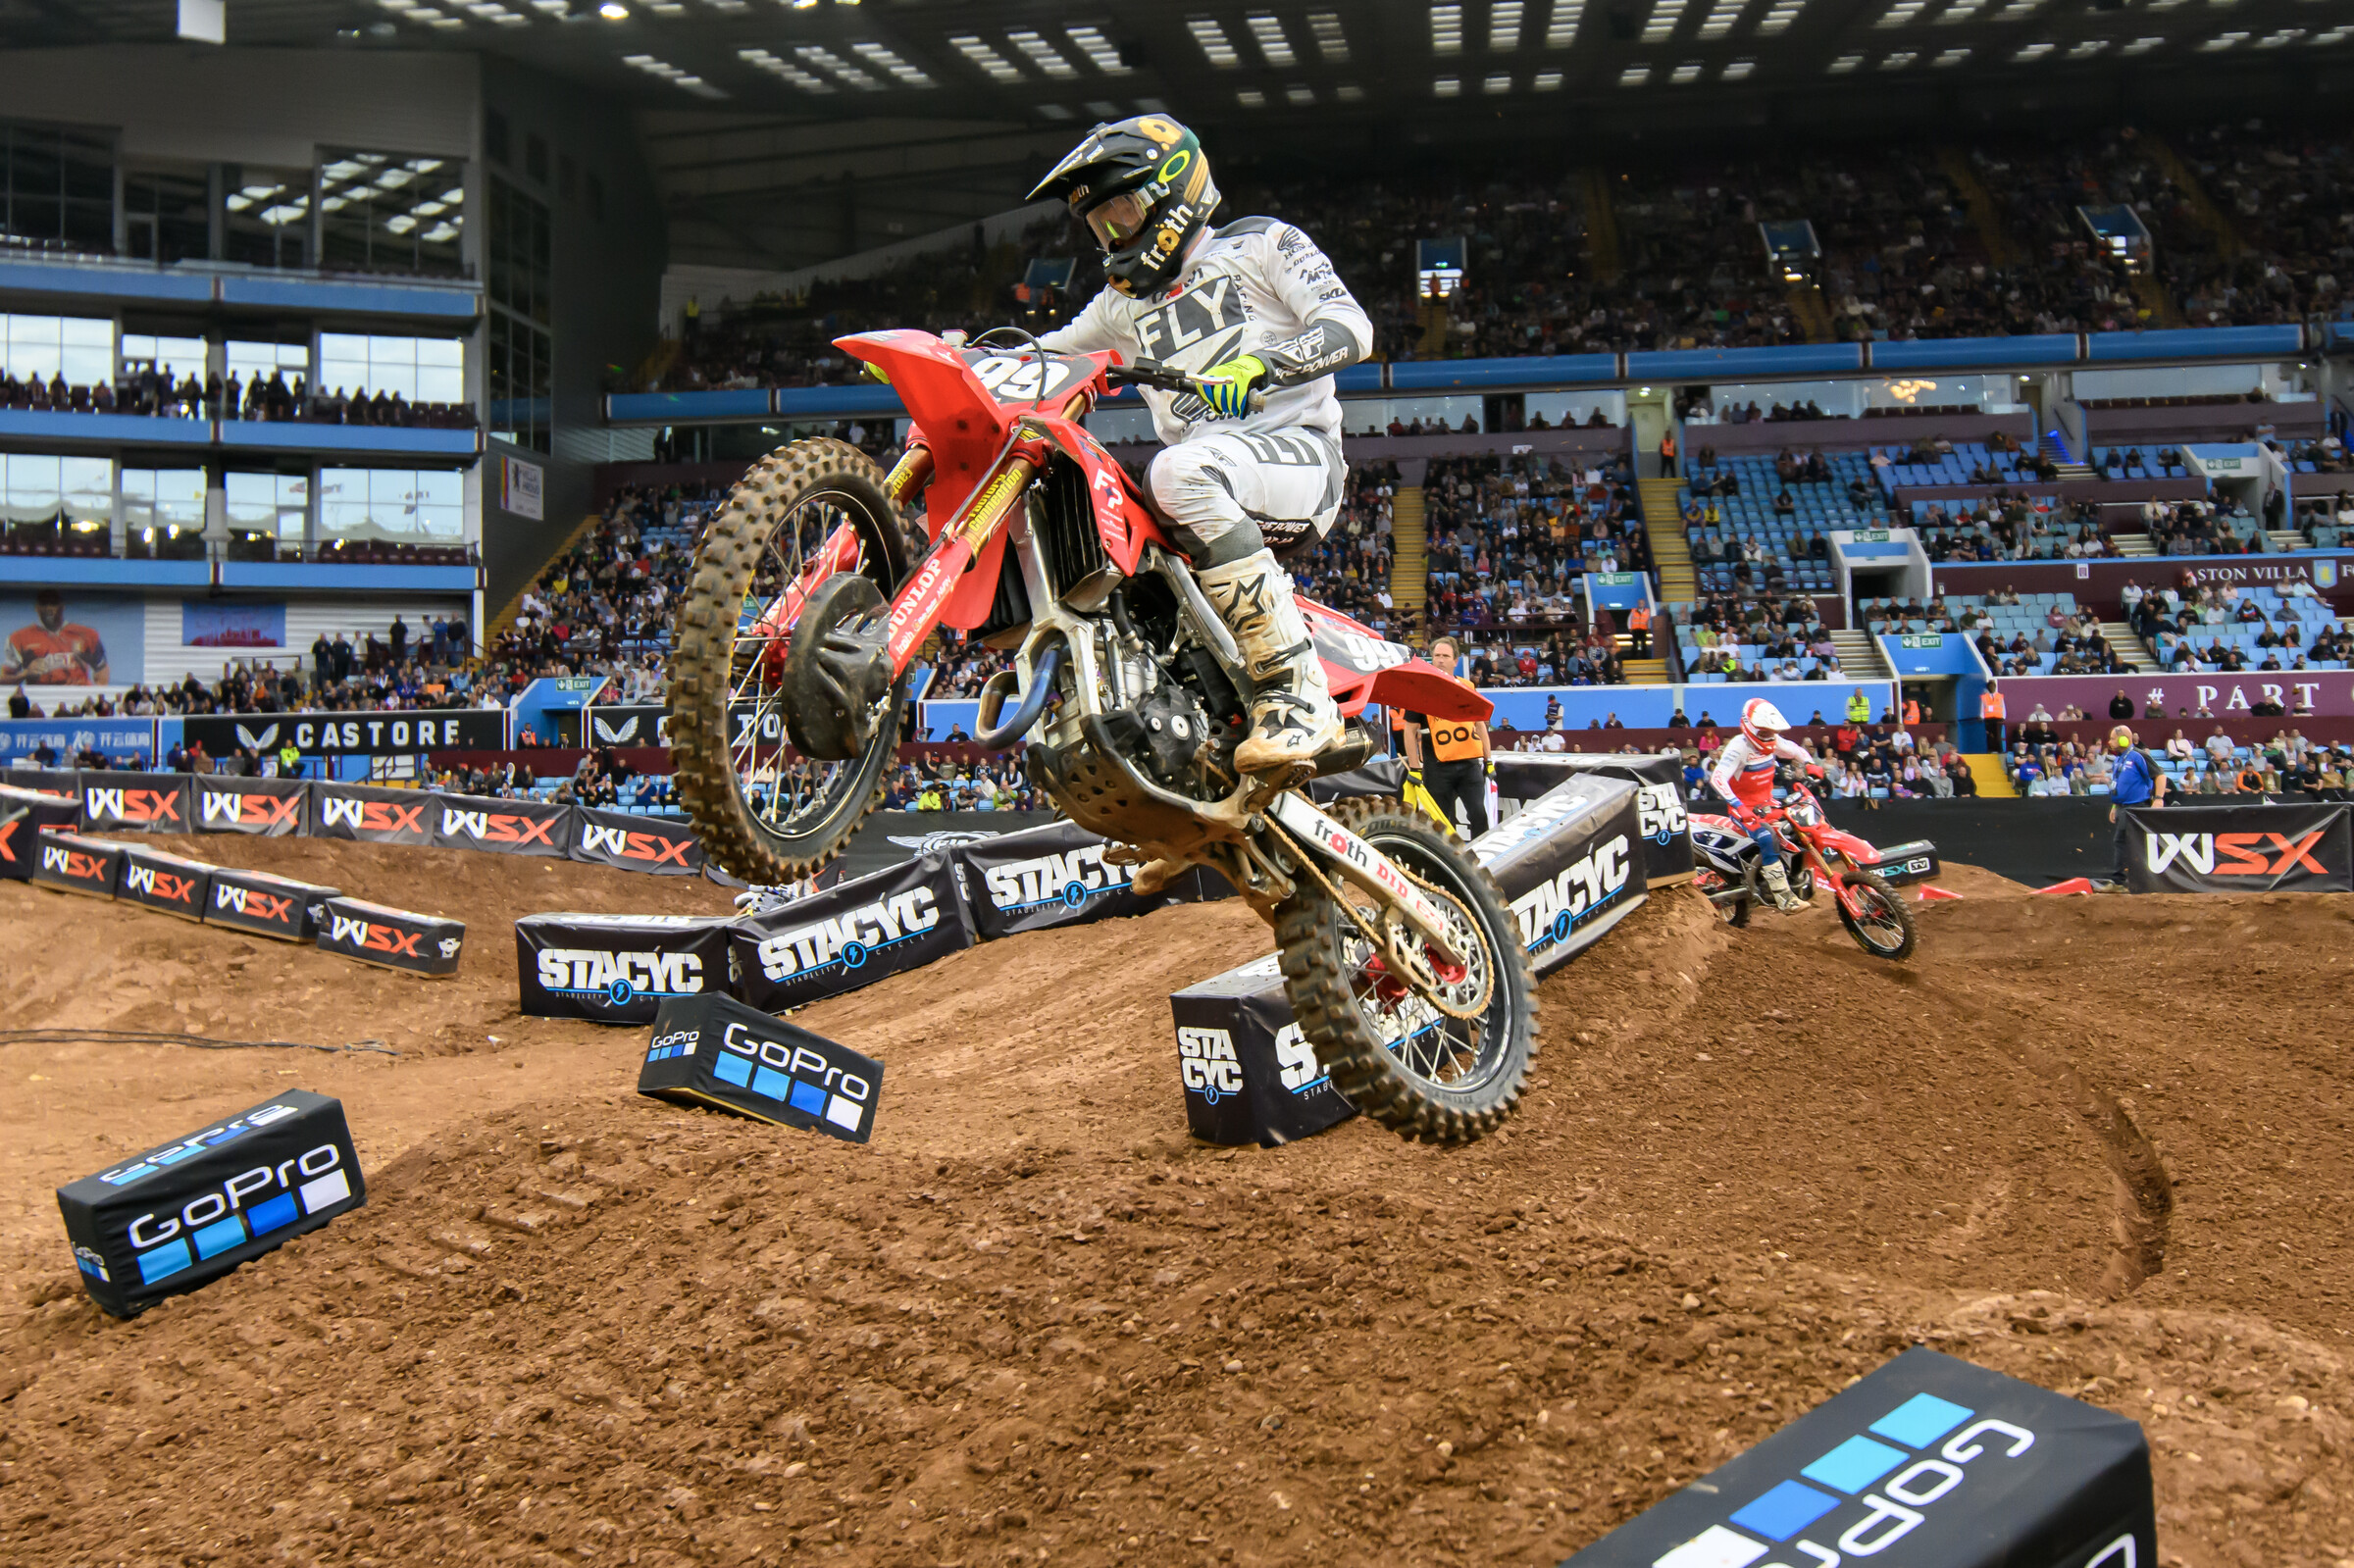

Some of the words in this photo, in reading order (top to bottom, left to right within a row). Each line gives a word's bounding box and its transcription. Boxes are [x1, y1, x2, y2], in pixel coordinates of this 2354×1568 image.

[1135, 277, 1230, 359] FLY
[1871, 531, 1889, 540] EXIT
[1614, 575, 1632, 583] EXIT
[2198, 568, 2247, 582] STON
[2252, 566, 2309, 580] VILLA
[2341, 564, 2354, 578] F
[888, 558, 942, 642] DUNLOP
[1343, 632, 1406, 672] 99
[1921, 637, 1941, 646] EXIT
[574, 680, 590, 688] EXIT
[296, 719, 460, 748] CASTORE
[86, 787, 180, 821] WSX
[202, 791, 299, 827] WSX
[1638, 782, 1681, 812] STA
[323, 797, 425, 834] WSX
[441, 809, 556, 845] WSX
[1639, 806, 1687, 837] CYC
[582, 824, 693, 867] WSX
[2146, 831, 2330, 876] WSX
[43, 846, 107, 882] WSX
[985, 840, 1142, 908] STACY
[1376, 863, 1408, 899] DID
[127, 864, 195, 903] WSX
[1095, 887, 1135, 901] CYCL
[1509, 835, 1630, 947] TACYC
[216, 884, 293, 923] WSX
[331, 915, 423, 957] WSX
[756, 885, 941, 981] STACYC
[875, 933, 926, 956] CYCLE
[537, 947, 704, 993] STACYC
[651, 1030, 700, 1049] GoPro
[1178, 1026, 1237, 1061] STA
[723, 1022, 871, 1101] GoPro
[1181, 1057, 1244, 1091] CYC
[1304, 1080, 1334, 1100] STABI
[98, 1104, 284, 1184] GoPro
[128, 1143, 340, 1249] GoPro
[1760, 1418, 2036, 1568] GoPr
